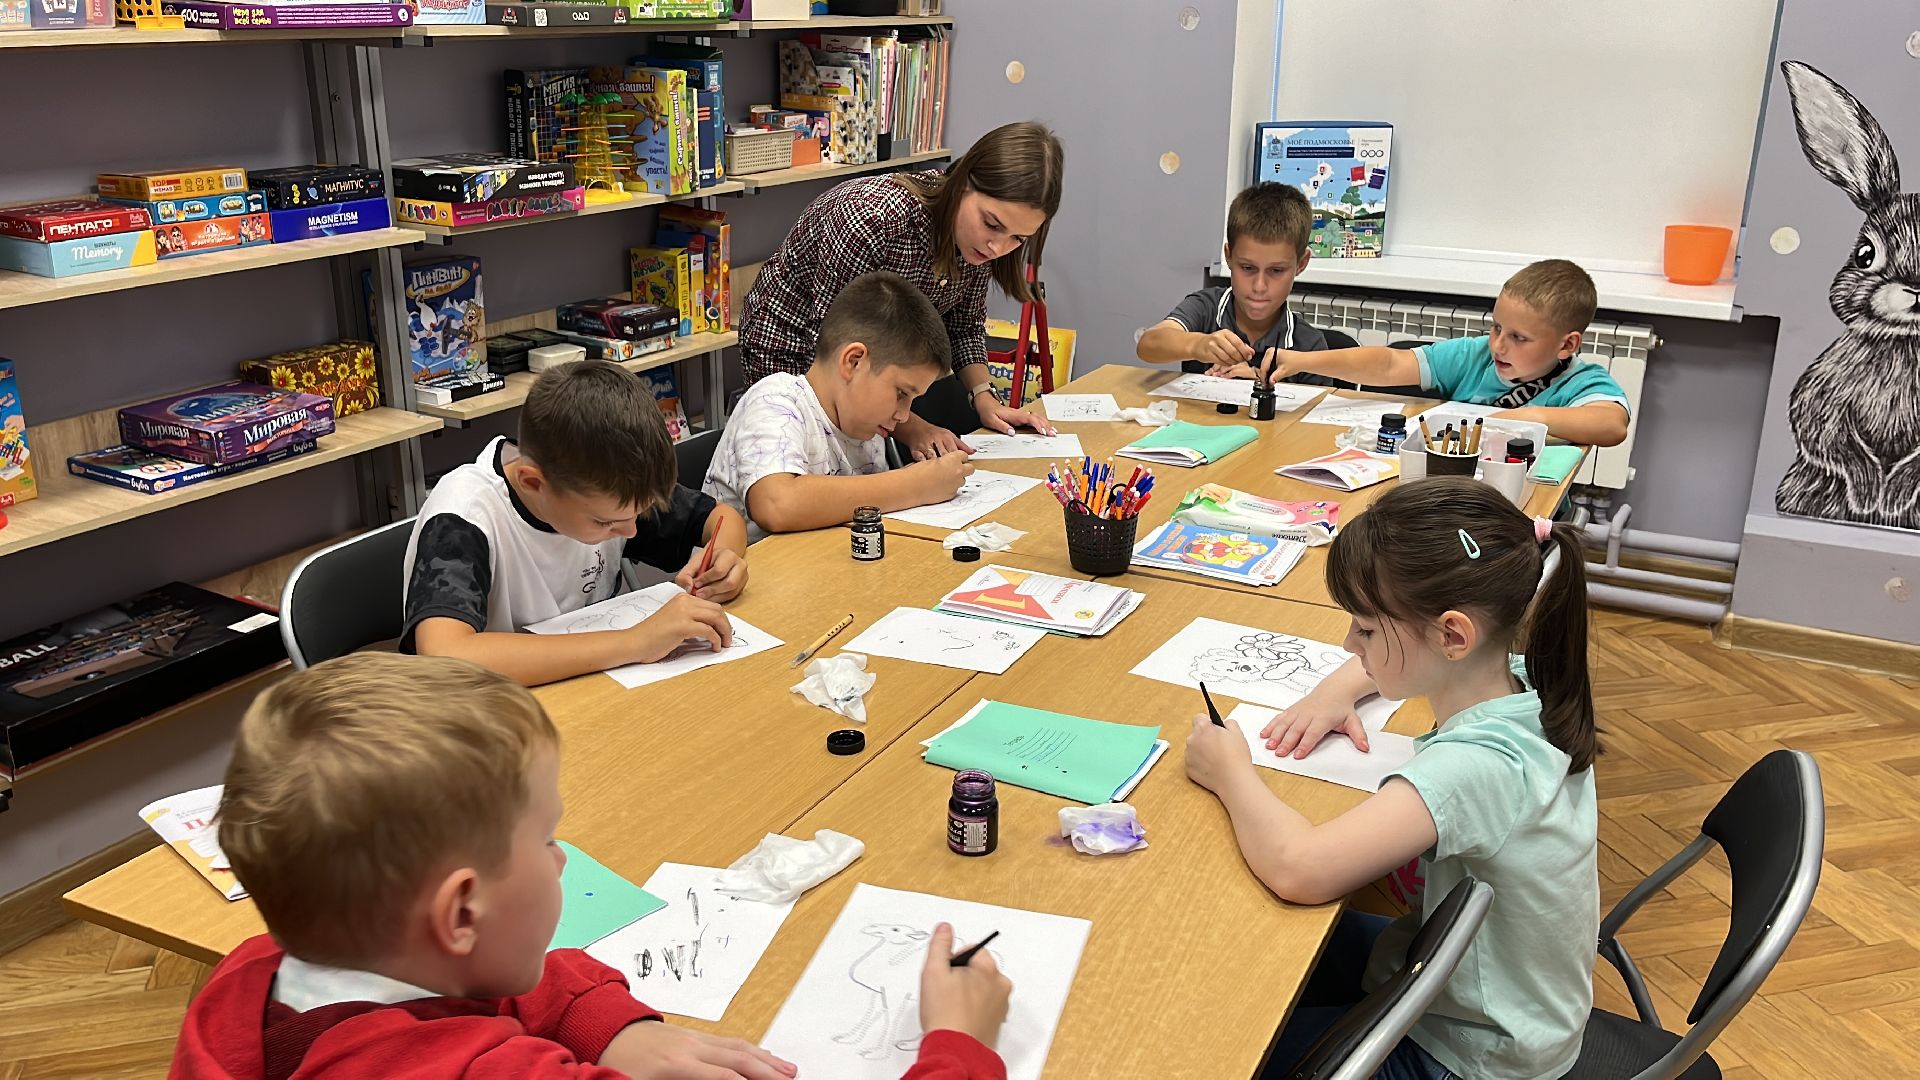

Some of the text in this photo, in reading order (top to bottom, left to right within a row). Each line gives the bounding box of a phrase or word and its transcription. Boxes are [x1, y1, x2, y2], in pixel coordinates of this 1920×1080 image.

[543, 76, 575, 96] МАГИЯ
[619, 75, 655, 93] башня!
[324, 179, 364, 193] МАГНИТУС
[308, 211, 358, 226] MAGNETISM
[49, 219, 113, 236] ПЕНТАГО
[71, 245, 124, 261] Memory
[139, 421, 190, 439] Мировая
[243, 408, 308, 445] Мировая
